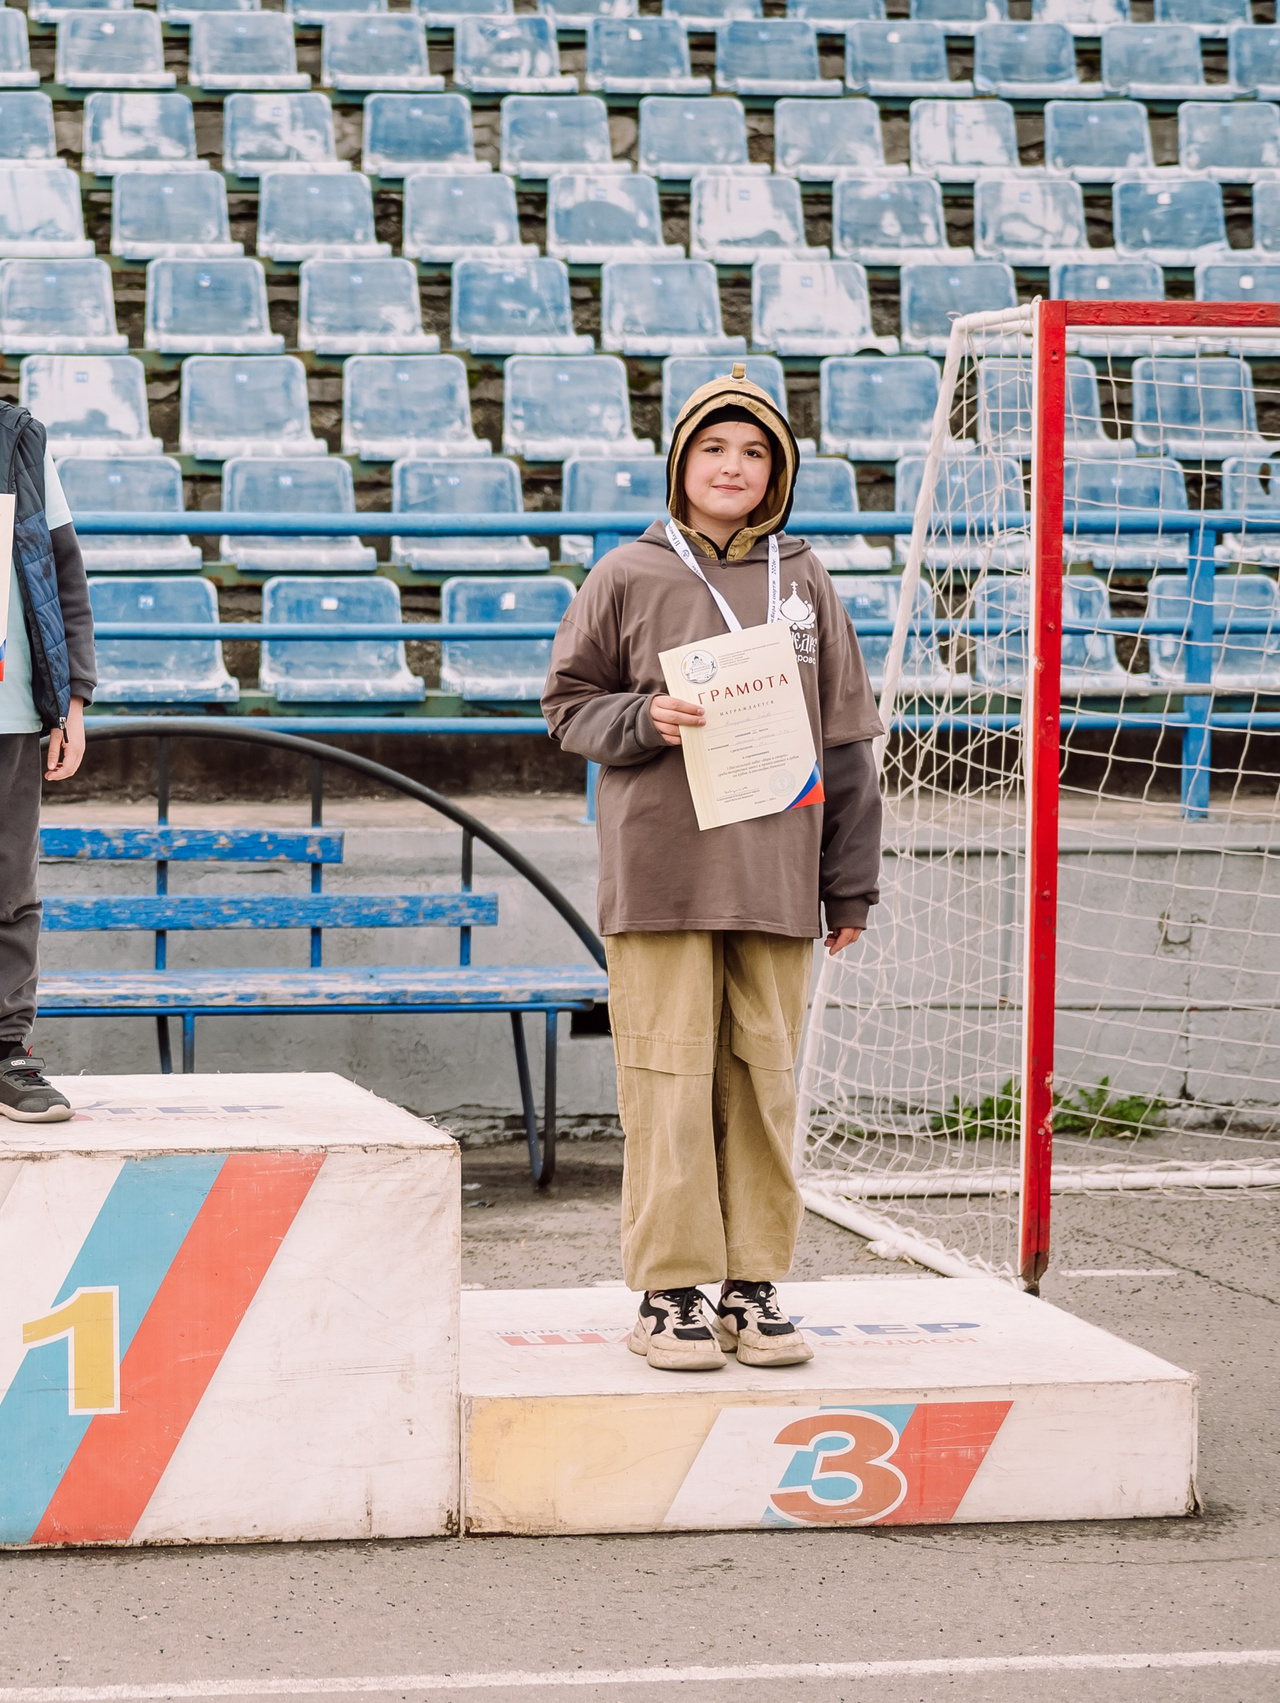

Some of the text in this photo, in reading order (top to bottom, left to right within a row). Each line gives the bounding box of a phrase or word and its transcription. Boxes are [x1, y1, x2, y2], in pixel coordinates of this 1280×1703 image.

[698, 673, 789, 705] ГРАМОТА
[720, 700, 774, 717] НАГРАЖДАЕТСЯ
[23, 1285, 120, 1415] 1
[820, 1336, 979, 1347] СТАДИОН
[770, 1408, 908, 1524] 3
